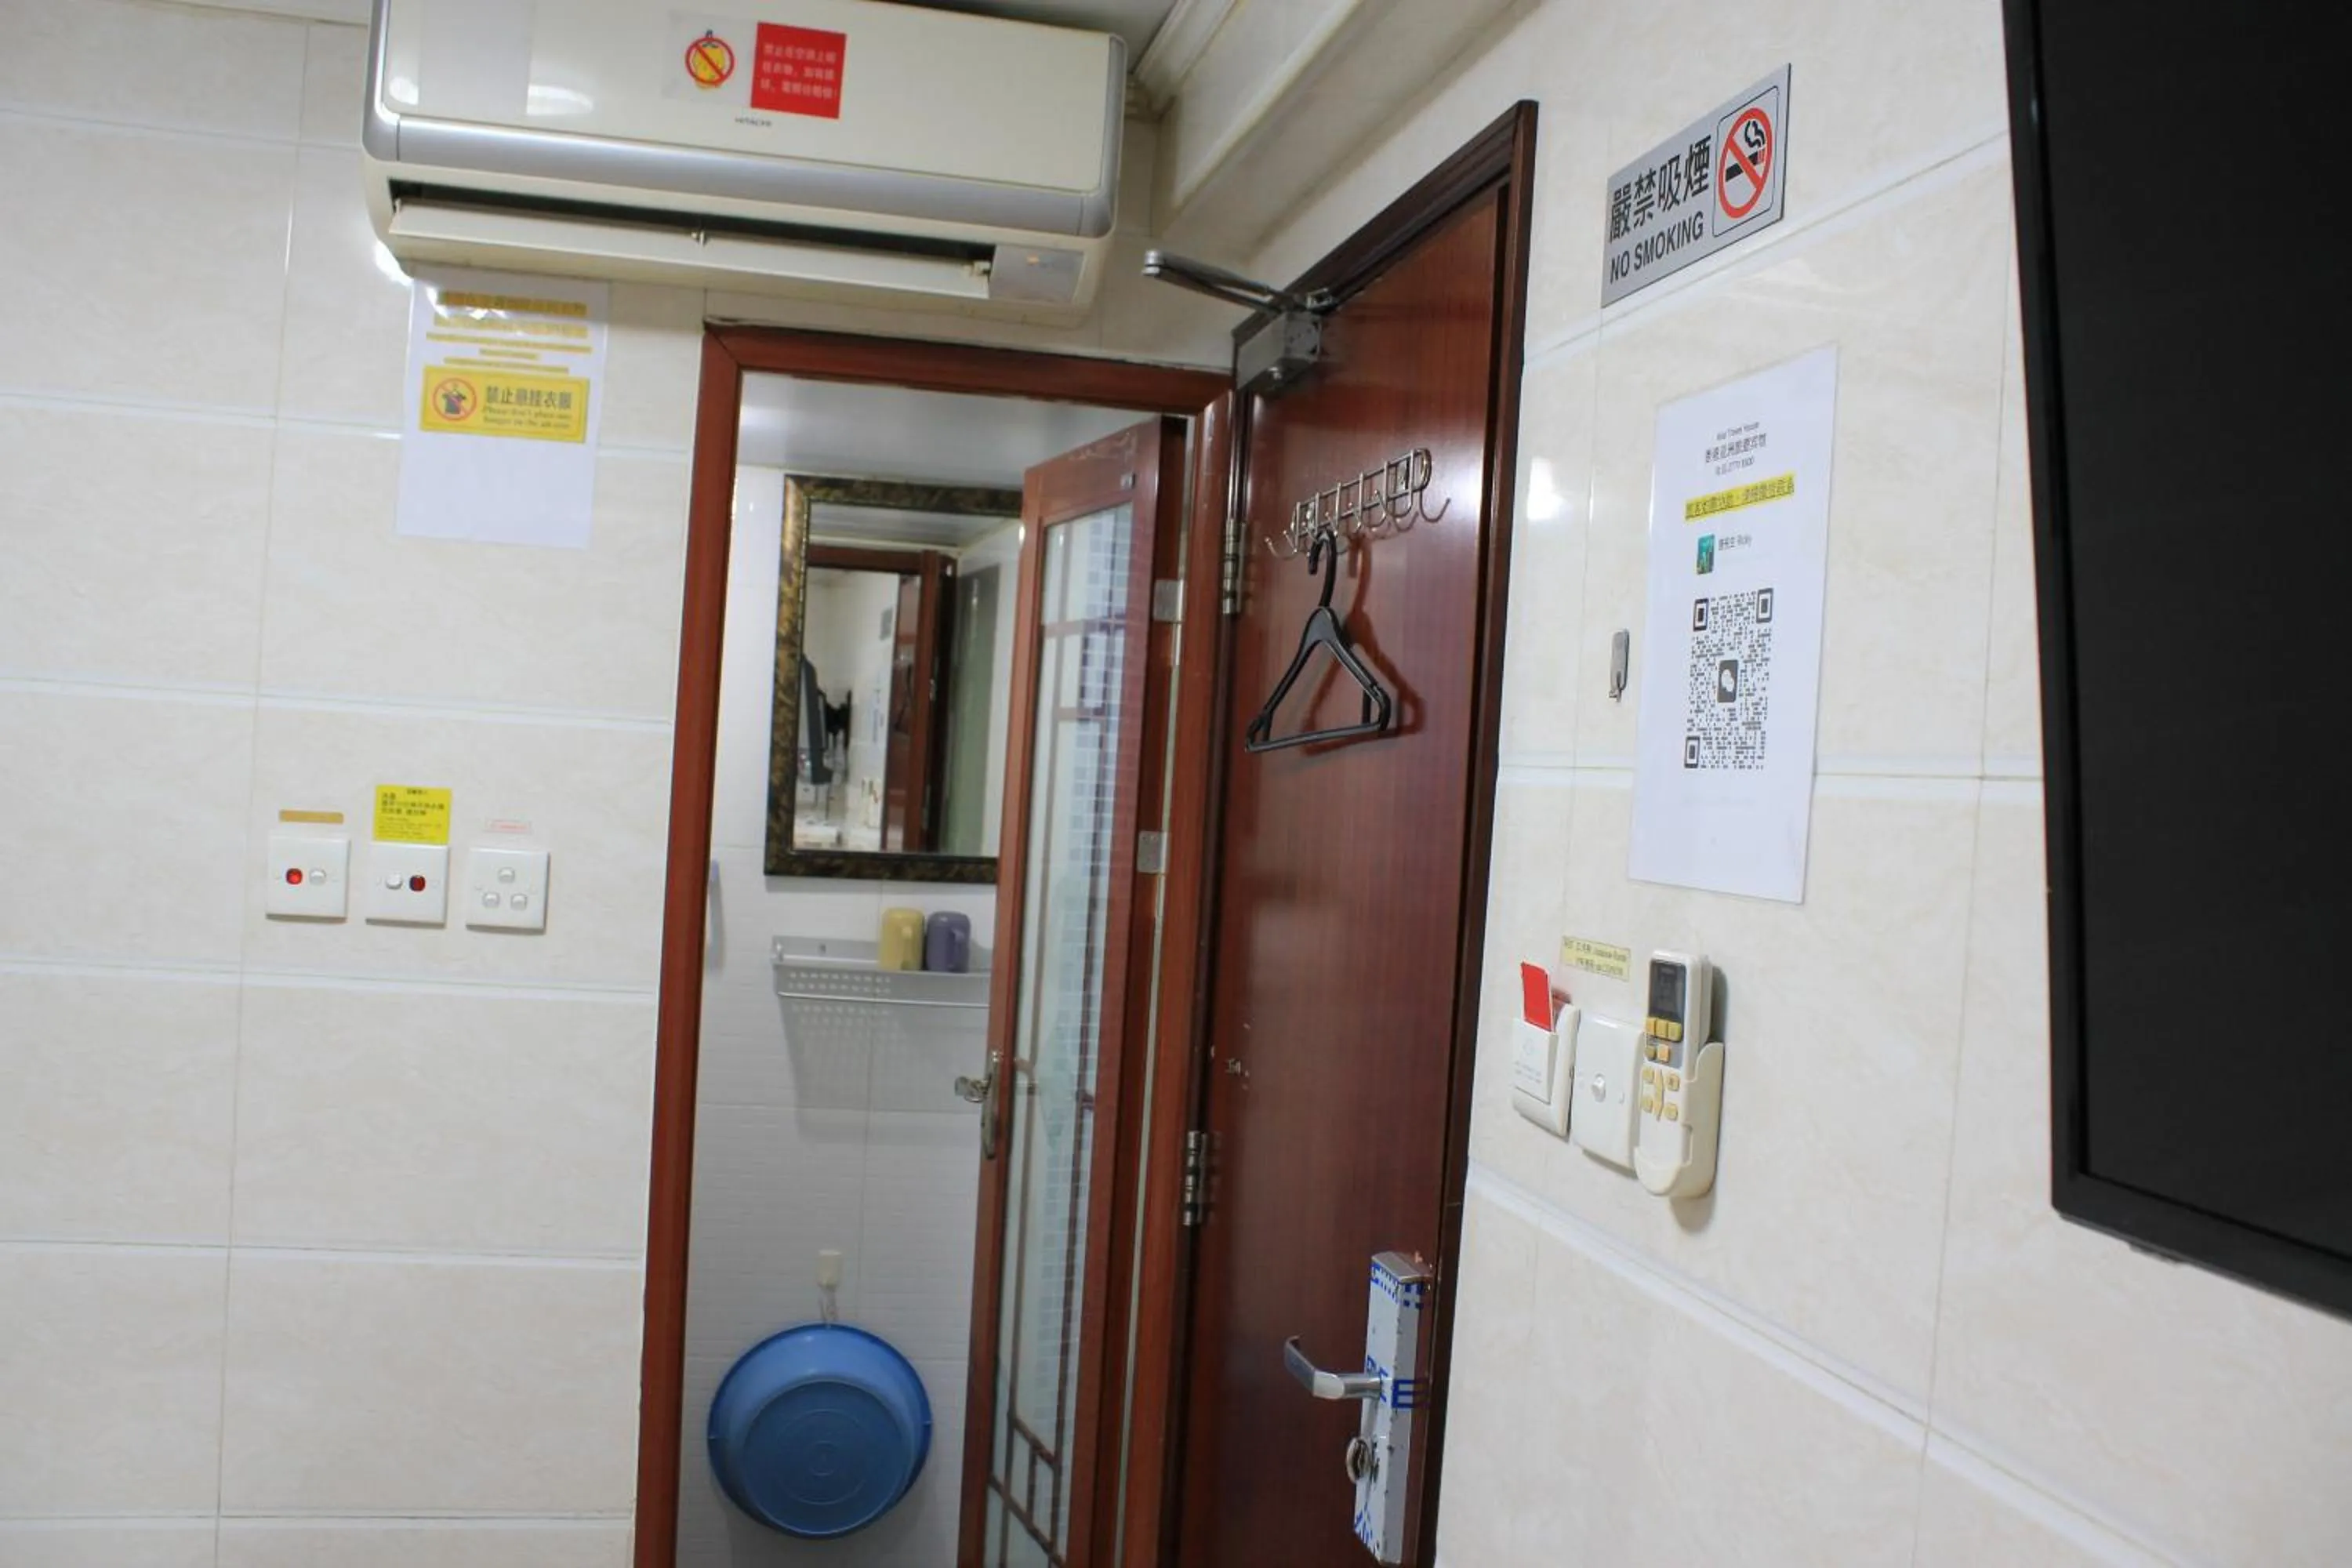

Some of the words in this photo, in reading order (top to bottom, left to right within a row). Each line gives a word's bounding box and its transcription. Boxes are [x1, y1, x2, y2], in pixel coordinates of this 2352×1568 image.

[1609, 134, 1711, 245] 嚴禁吸煙
[1610, 249, 1630, 285] NO
[1634, 210, 1704, 270] SMOKING
